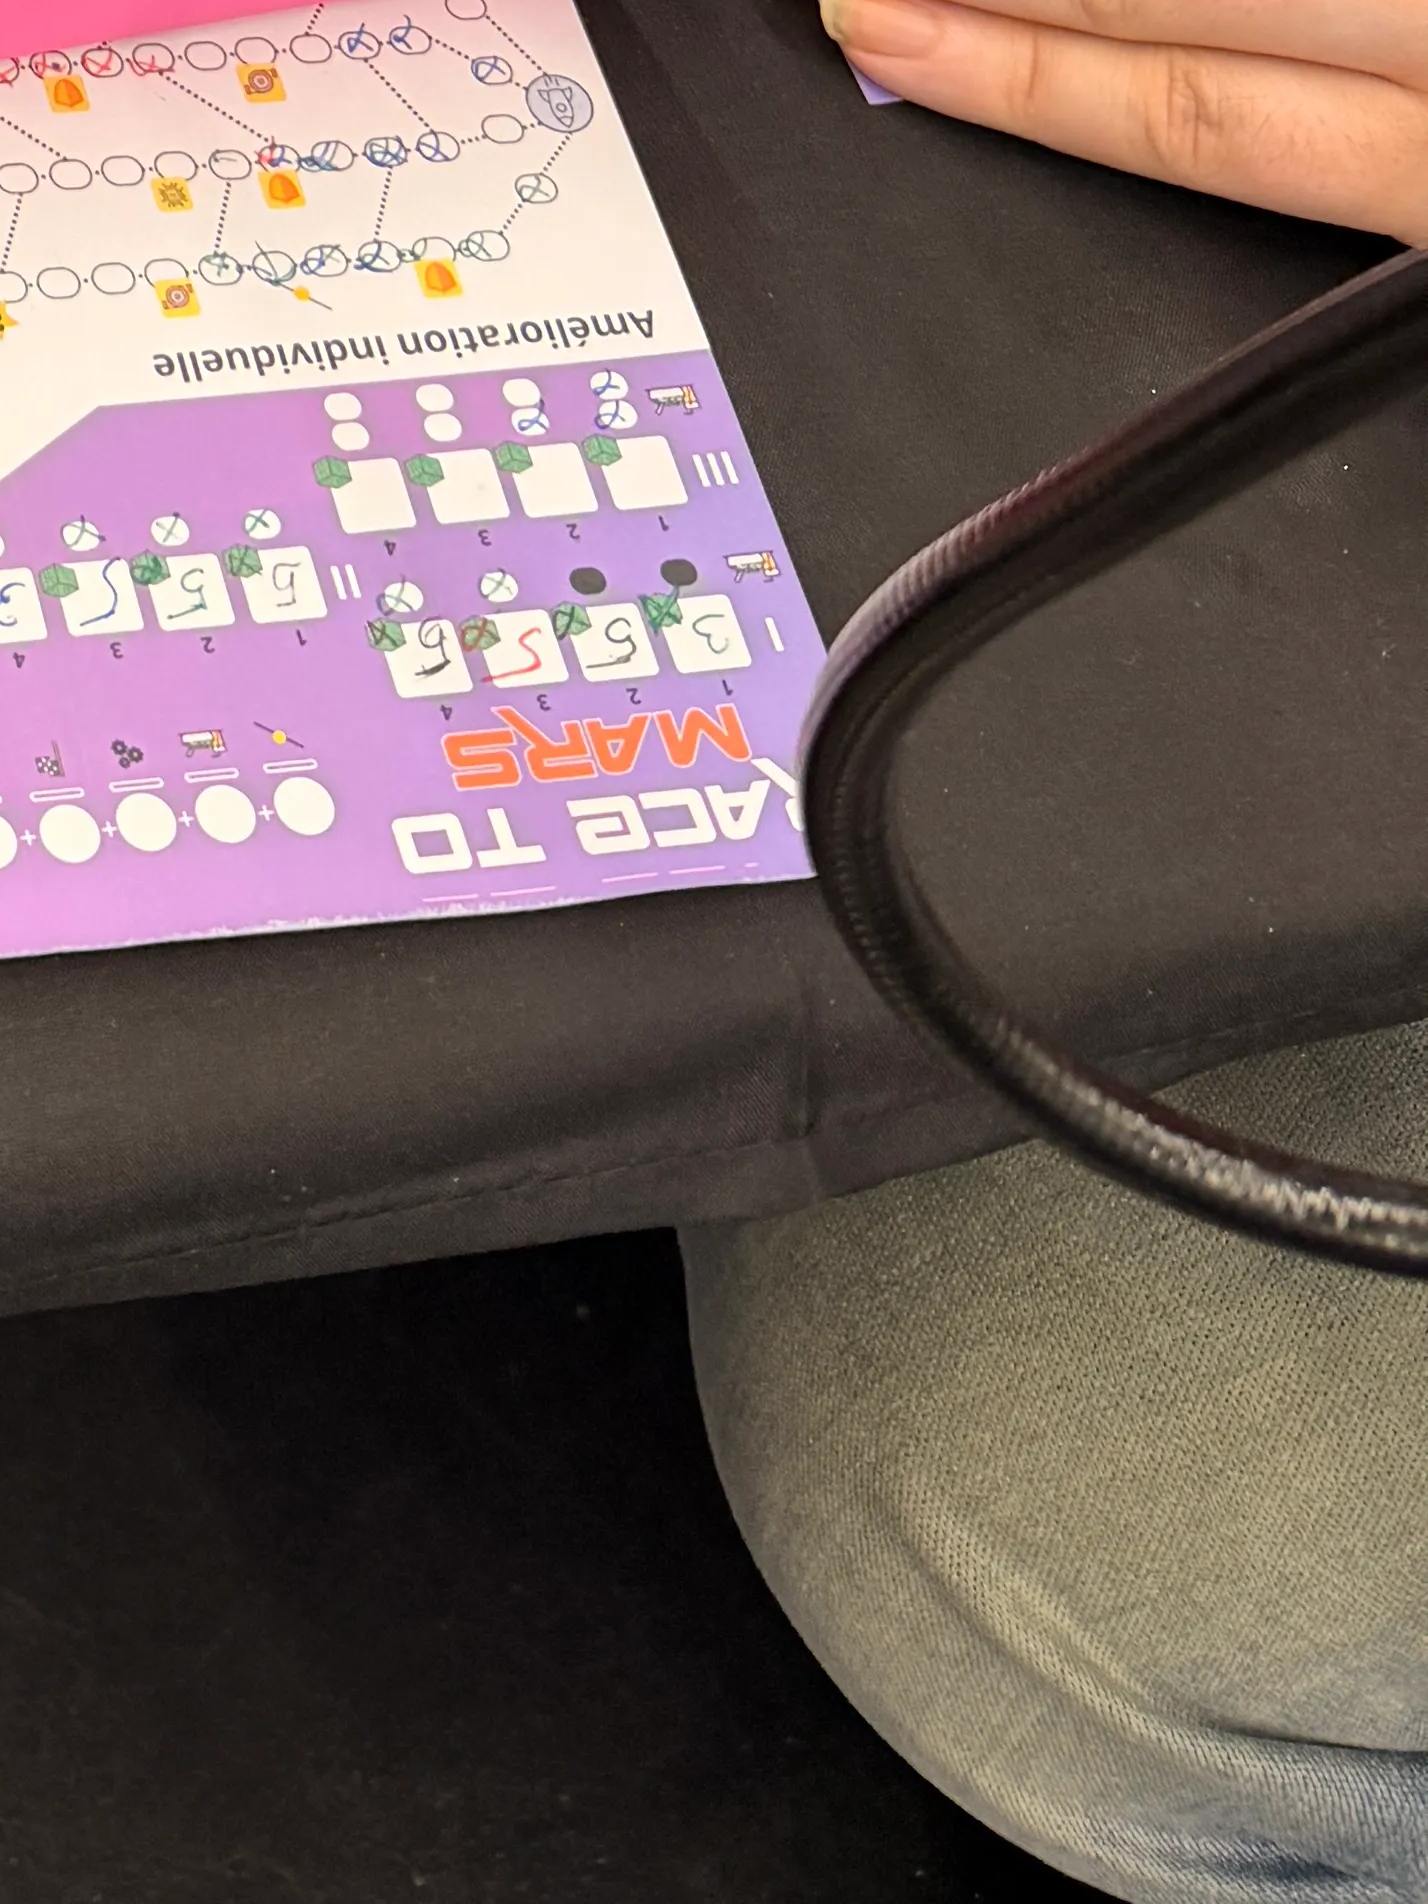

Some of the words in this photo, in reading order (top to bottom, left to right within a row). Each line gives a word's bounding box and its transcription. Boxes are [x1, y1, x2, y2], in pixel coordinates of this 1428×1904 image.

[397, 309, 655, 365] Amélioration
[152, 337, 389, 380] individuelle
[566, 523, 580, 540] 2
[656, 515, 670, 533] 1
[477, 528, 492, 546] 3
[383, 539, 398, 556] 4
[200, 636, 214, 654] 2
[295, 629, 307, 646] 1
[586, 617, 636, 669] 5
[109, 641, 124, 659] 3
[12, 651, 27, 669] 4
[626, 686, 642, 704] 2
[721, 678, 735, 696] 1
[439, 702, 454, 720] 4
[536, 693, 551, 711] 3
[441, 703, 753, 792] MARS
[391, 807, 547, 874] TO
